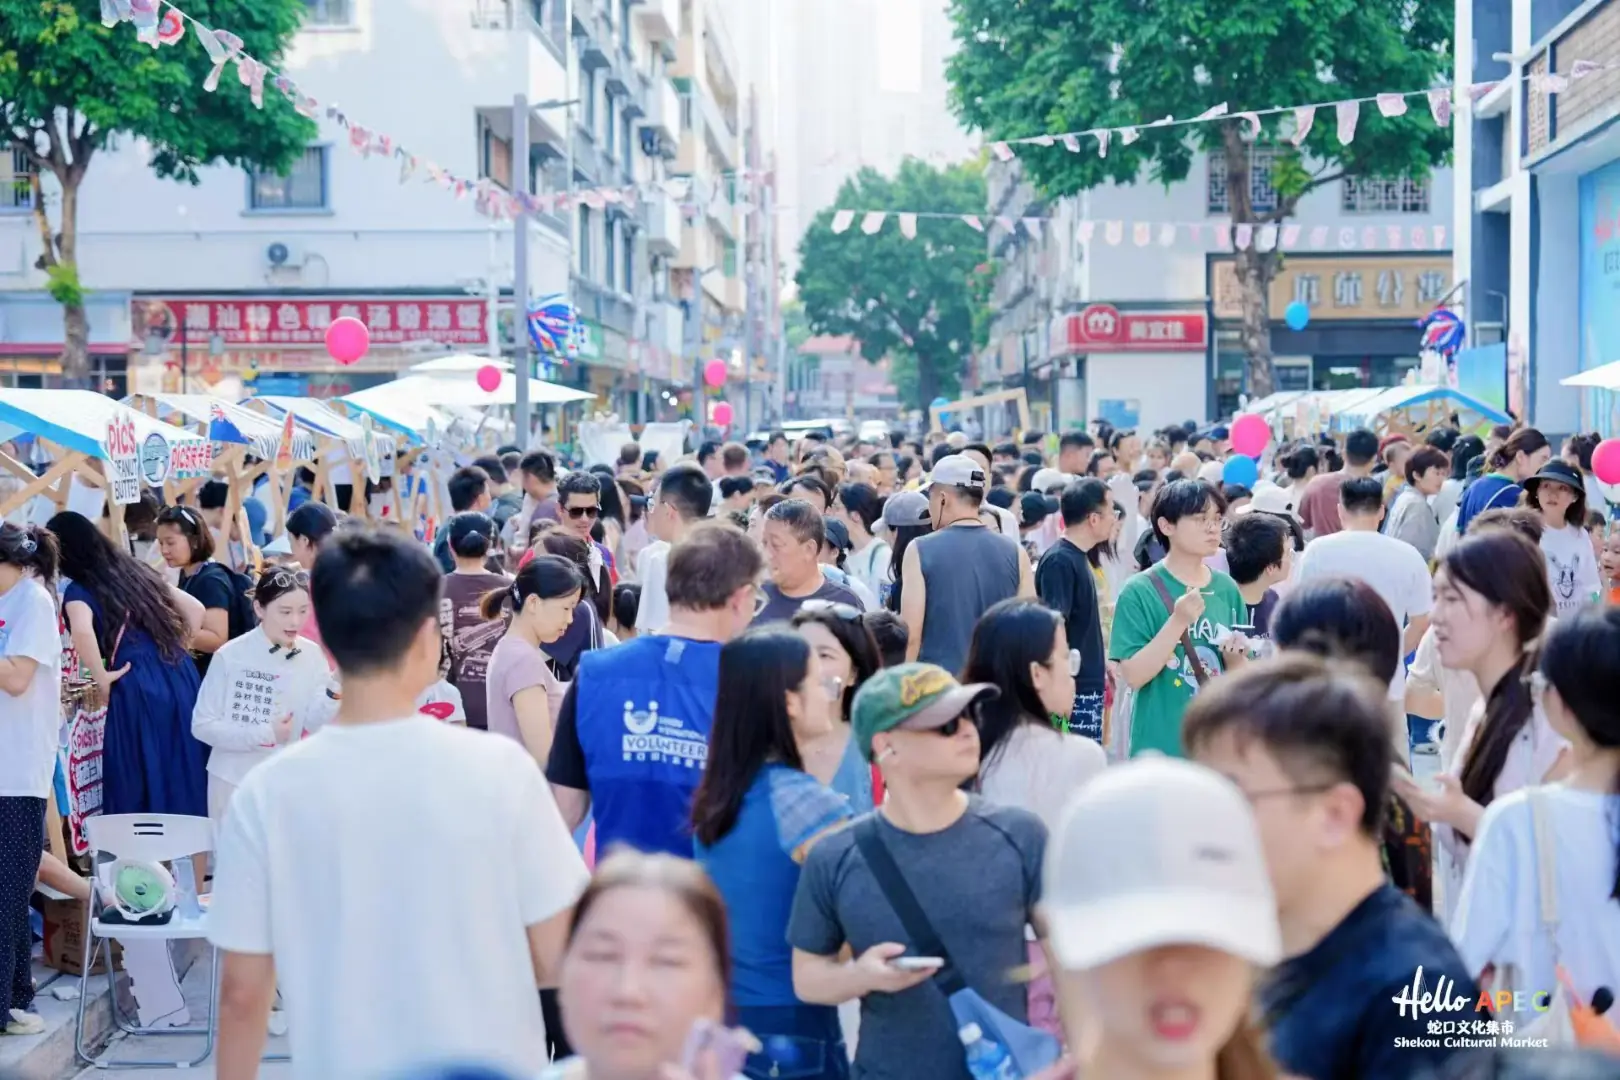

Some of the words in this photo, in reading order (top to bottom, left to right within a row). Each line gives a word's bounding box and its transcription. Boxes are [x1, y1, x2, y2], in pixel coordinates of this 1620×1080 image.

[232, 702, 271, 716] 老人小孩
[626, 738, 706, 758] VOLUNTEER
